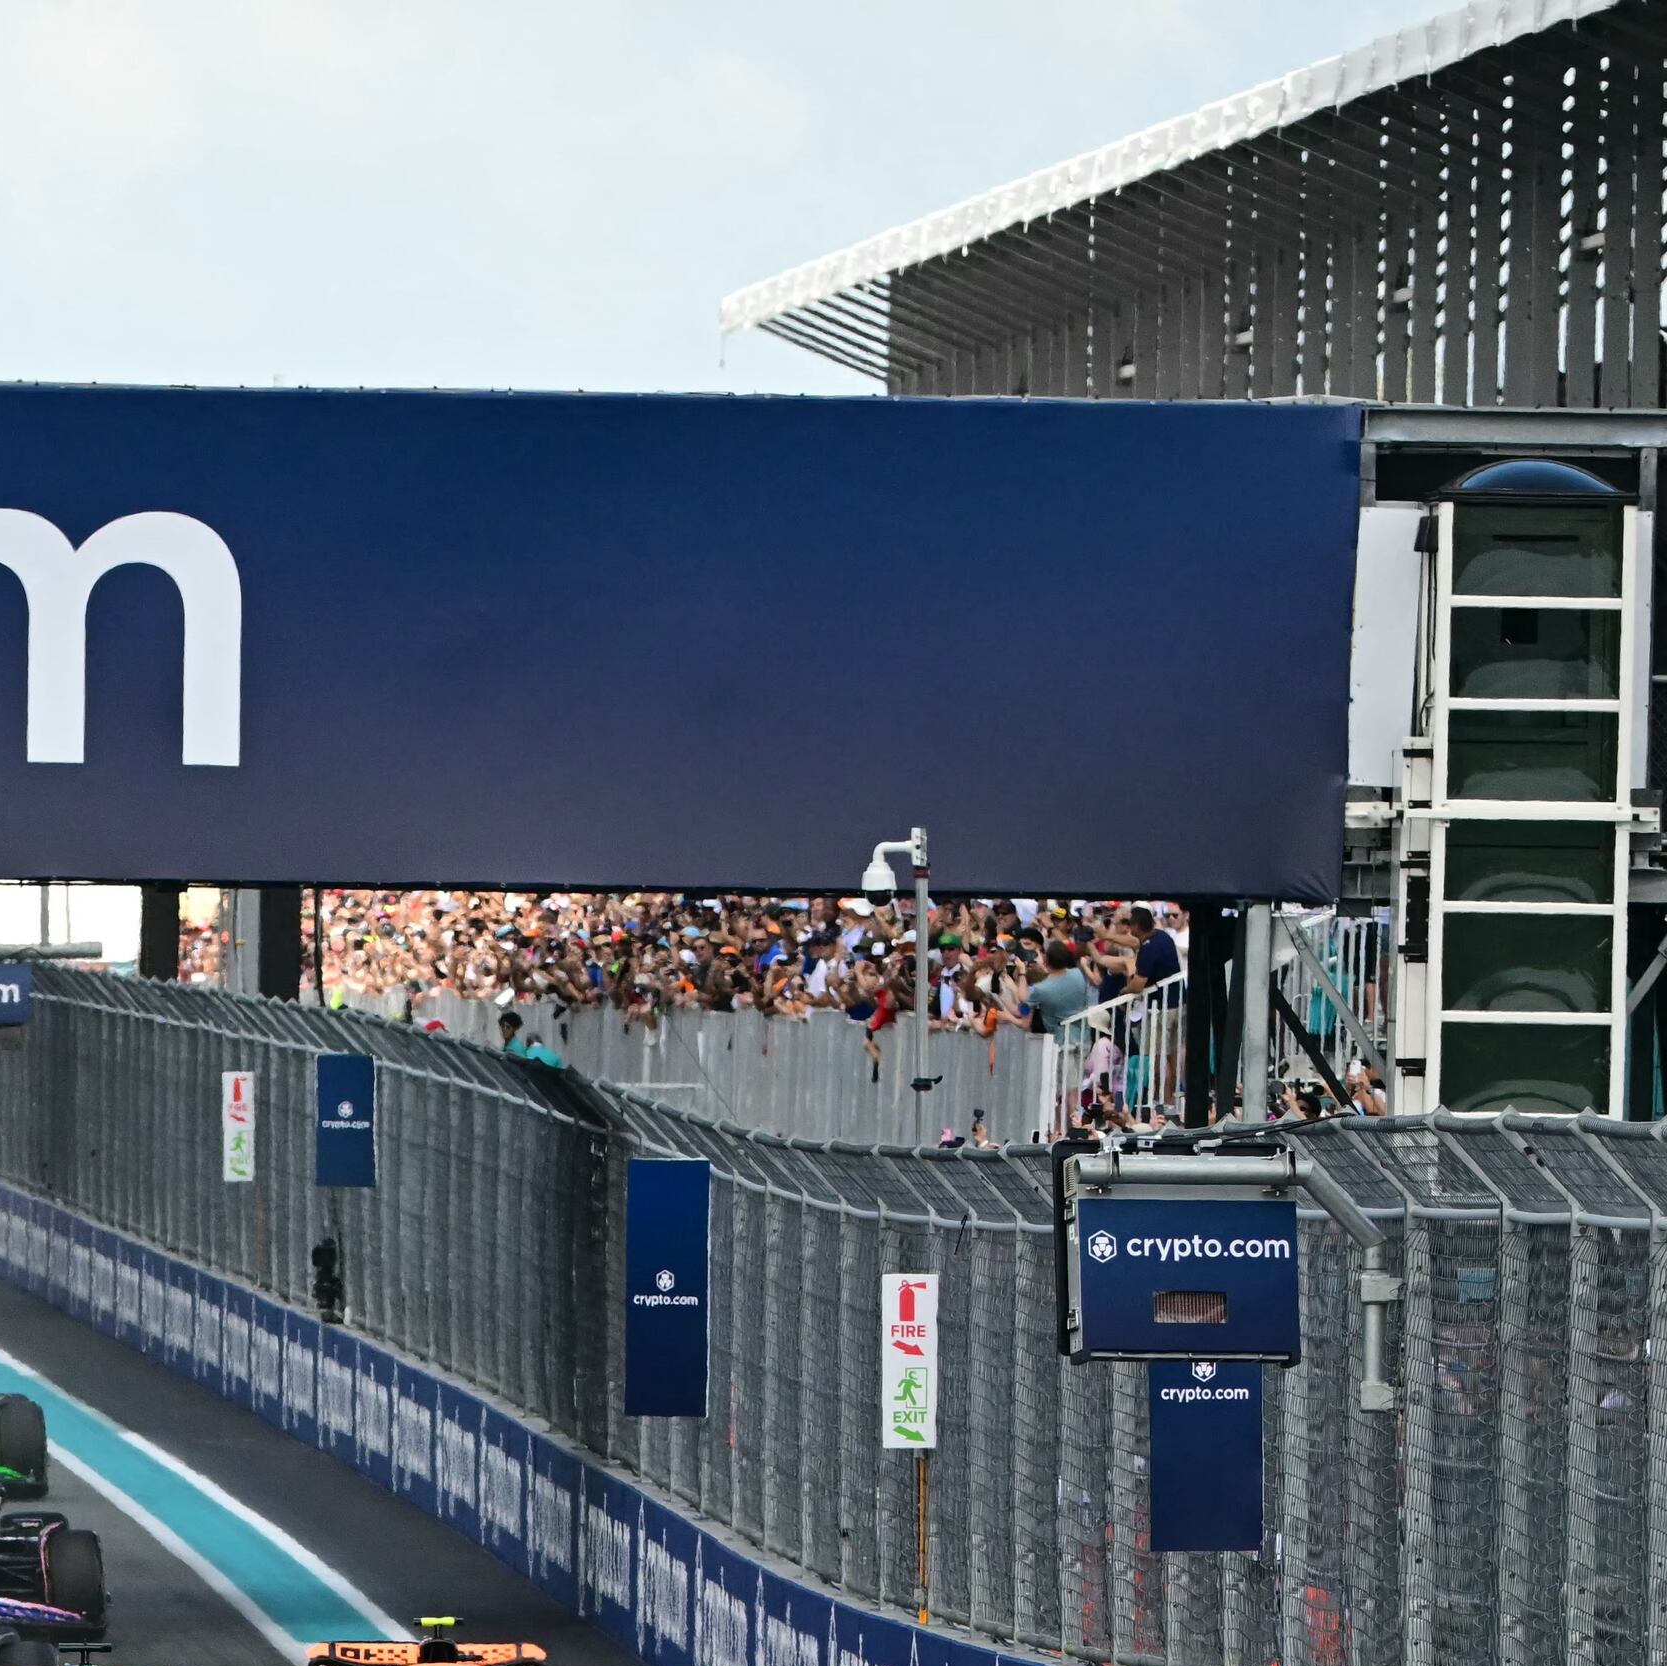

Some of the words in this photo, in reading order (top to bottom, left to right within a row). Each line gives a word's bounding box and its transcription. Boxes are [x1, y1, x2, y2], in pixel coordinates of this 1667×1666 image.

[1126, 1234, 1290, 1262] crypto.com
[633, 1292, 698, 1308] crypto.com
[890, 1325, 926, 1338] FIRE
[1160, 1384, 1249, 1402] crypto.com
[892, 1411, 928, 1424] EXIT
